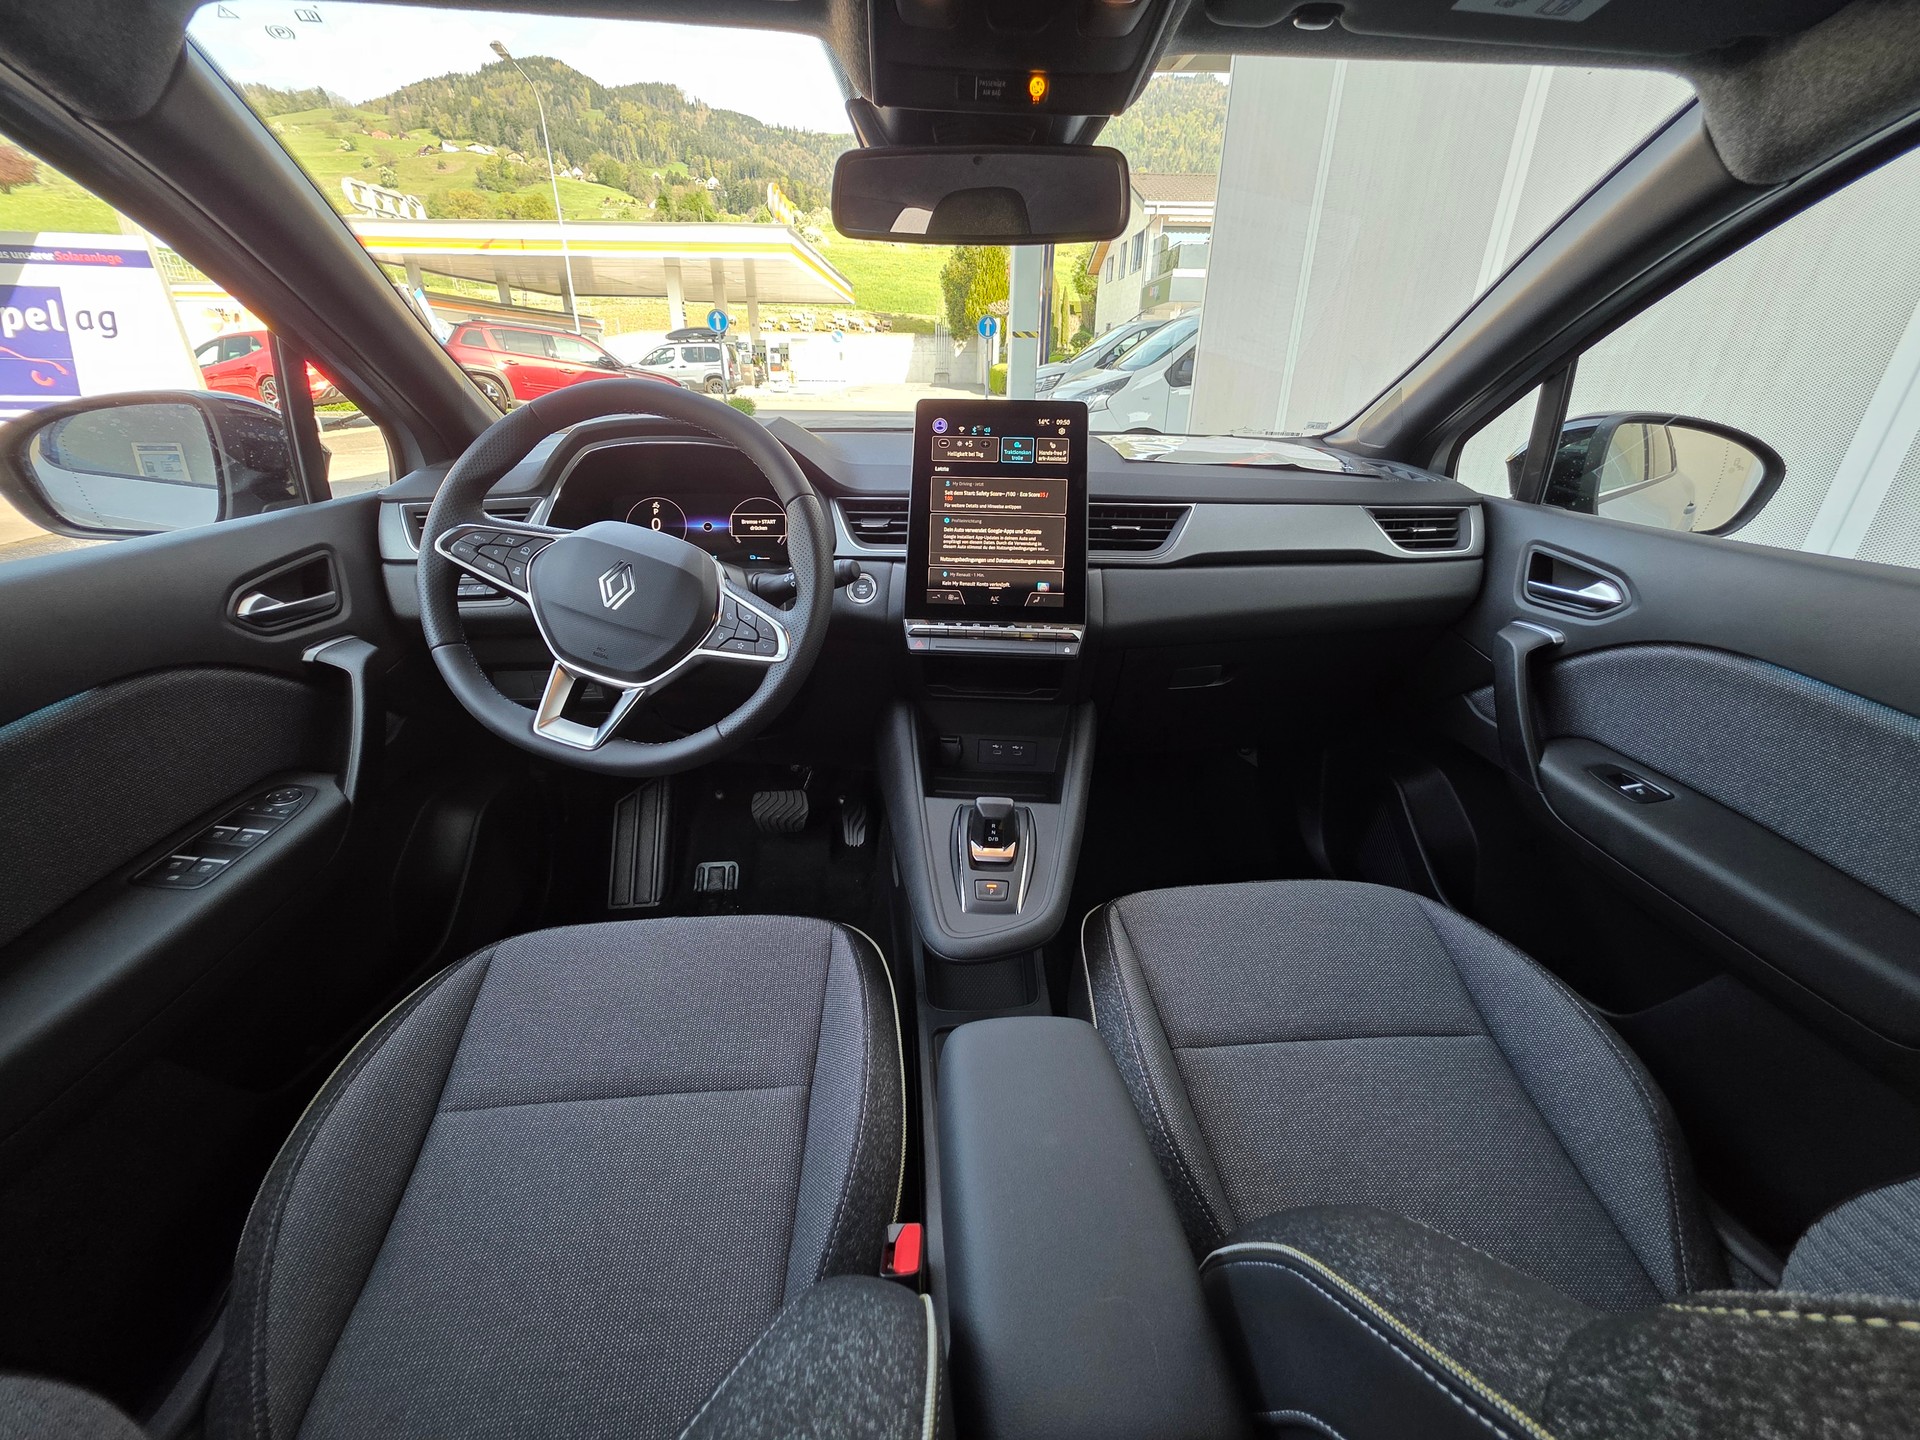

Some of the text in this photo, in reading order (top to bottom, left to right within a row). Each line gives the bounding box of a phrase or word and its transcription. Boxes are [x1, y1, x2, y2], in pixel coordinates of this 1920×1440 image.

[54, 250, 123, 266] Solaranlage
[0, 299, 118, 339] pel ag
[651, 517, 661, 531] 0
